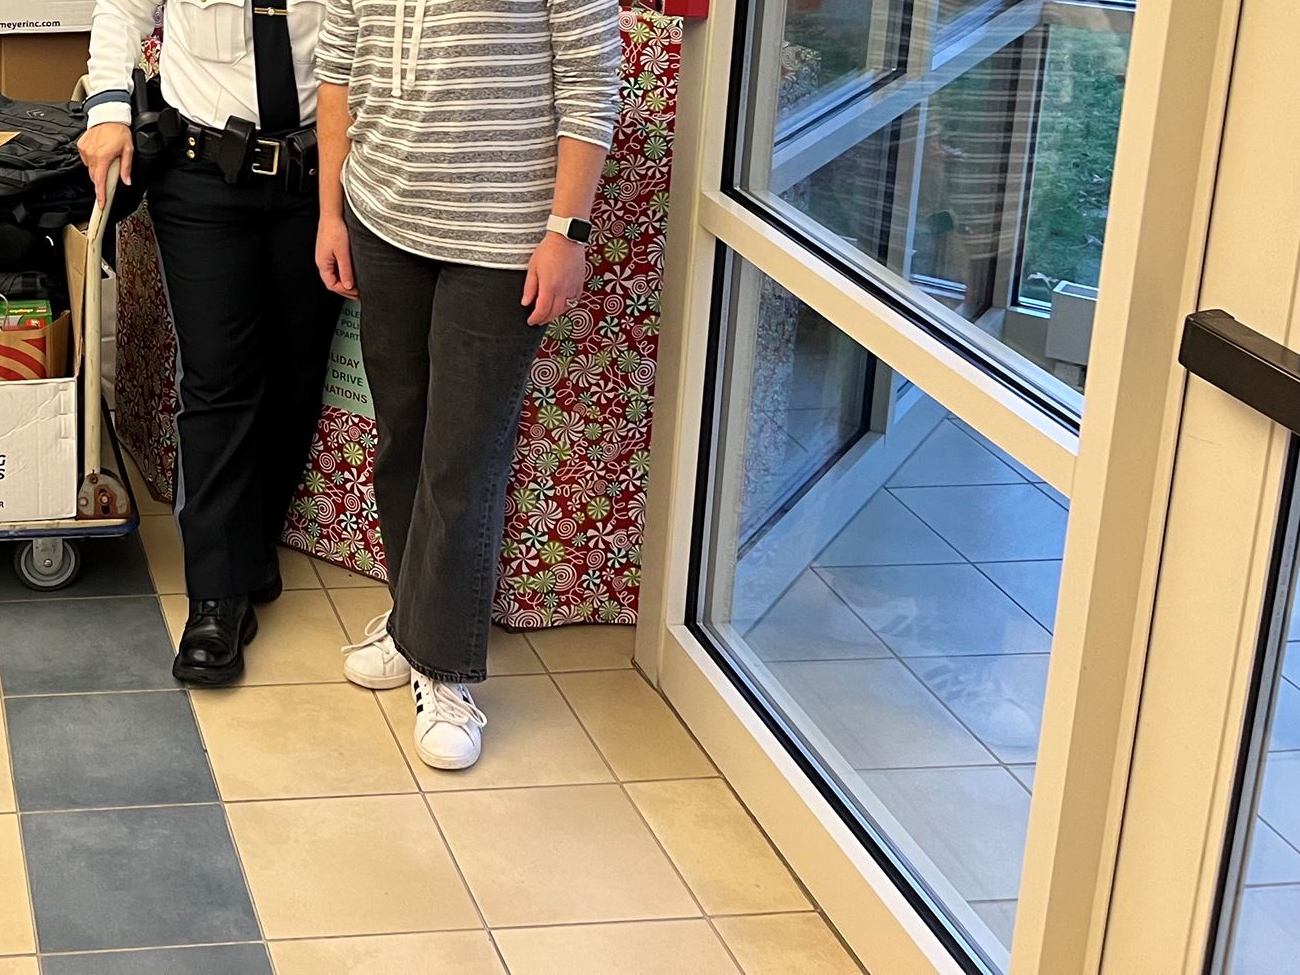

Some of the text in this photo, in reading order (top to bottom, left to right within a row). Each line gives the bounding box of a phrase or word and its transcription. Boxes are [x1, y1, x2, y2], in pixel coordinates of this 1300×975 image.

[340, 319, 360, 331] POLI
[330, 352, 360, 369] LIDAY
[332, 369, 364, 387] DRIVE
[324, 383, 368, 405] NATIONS
